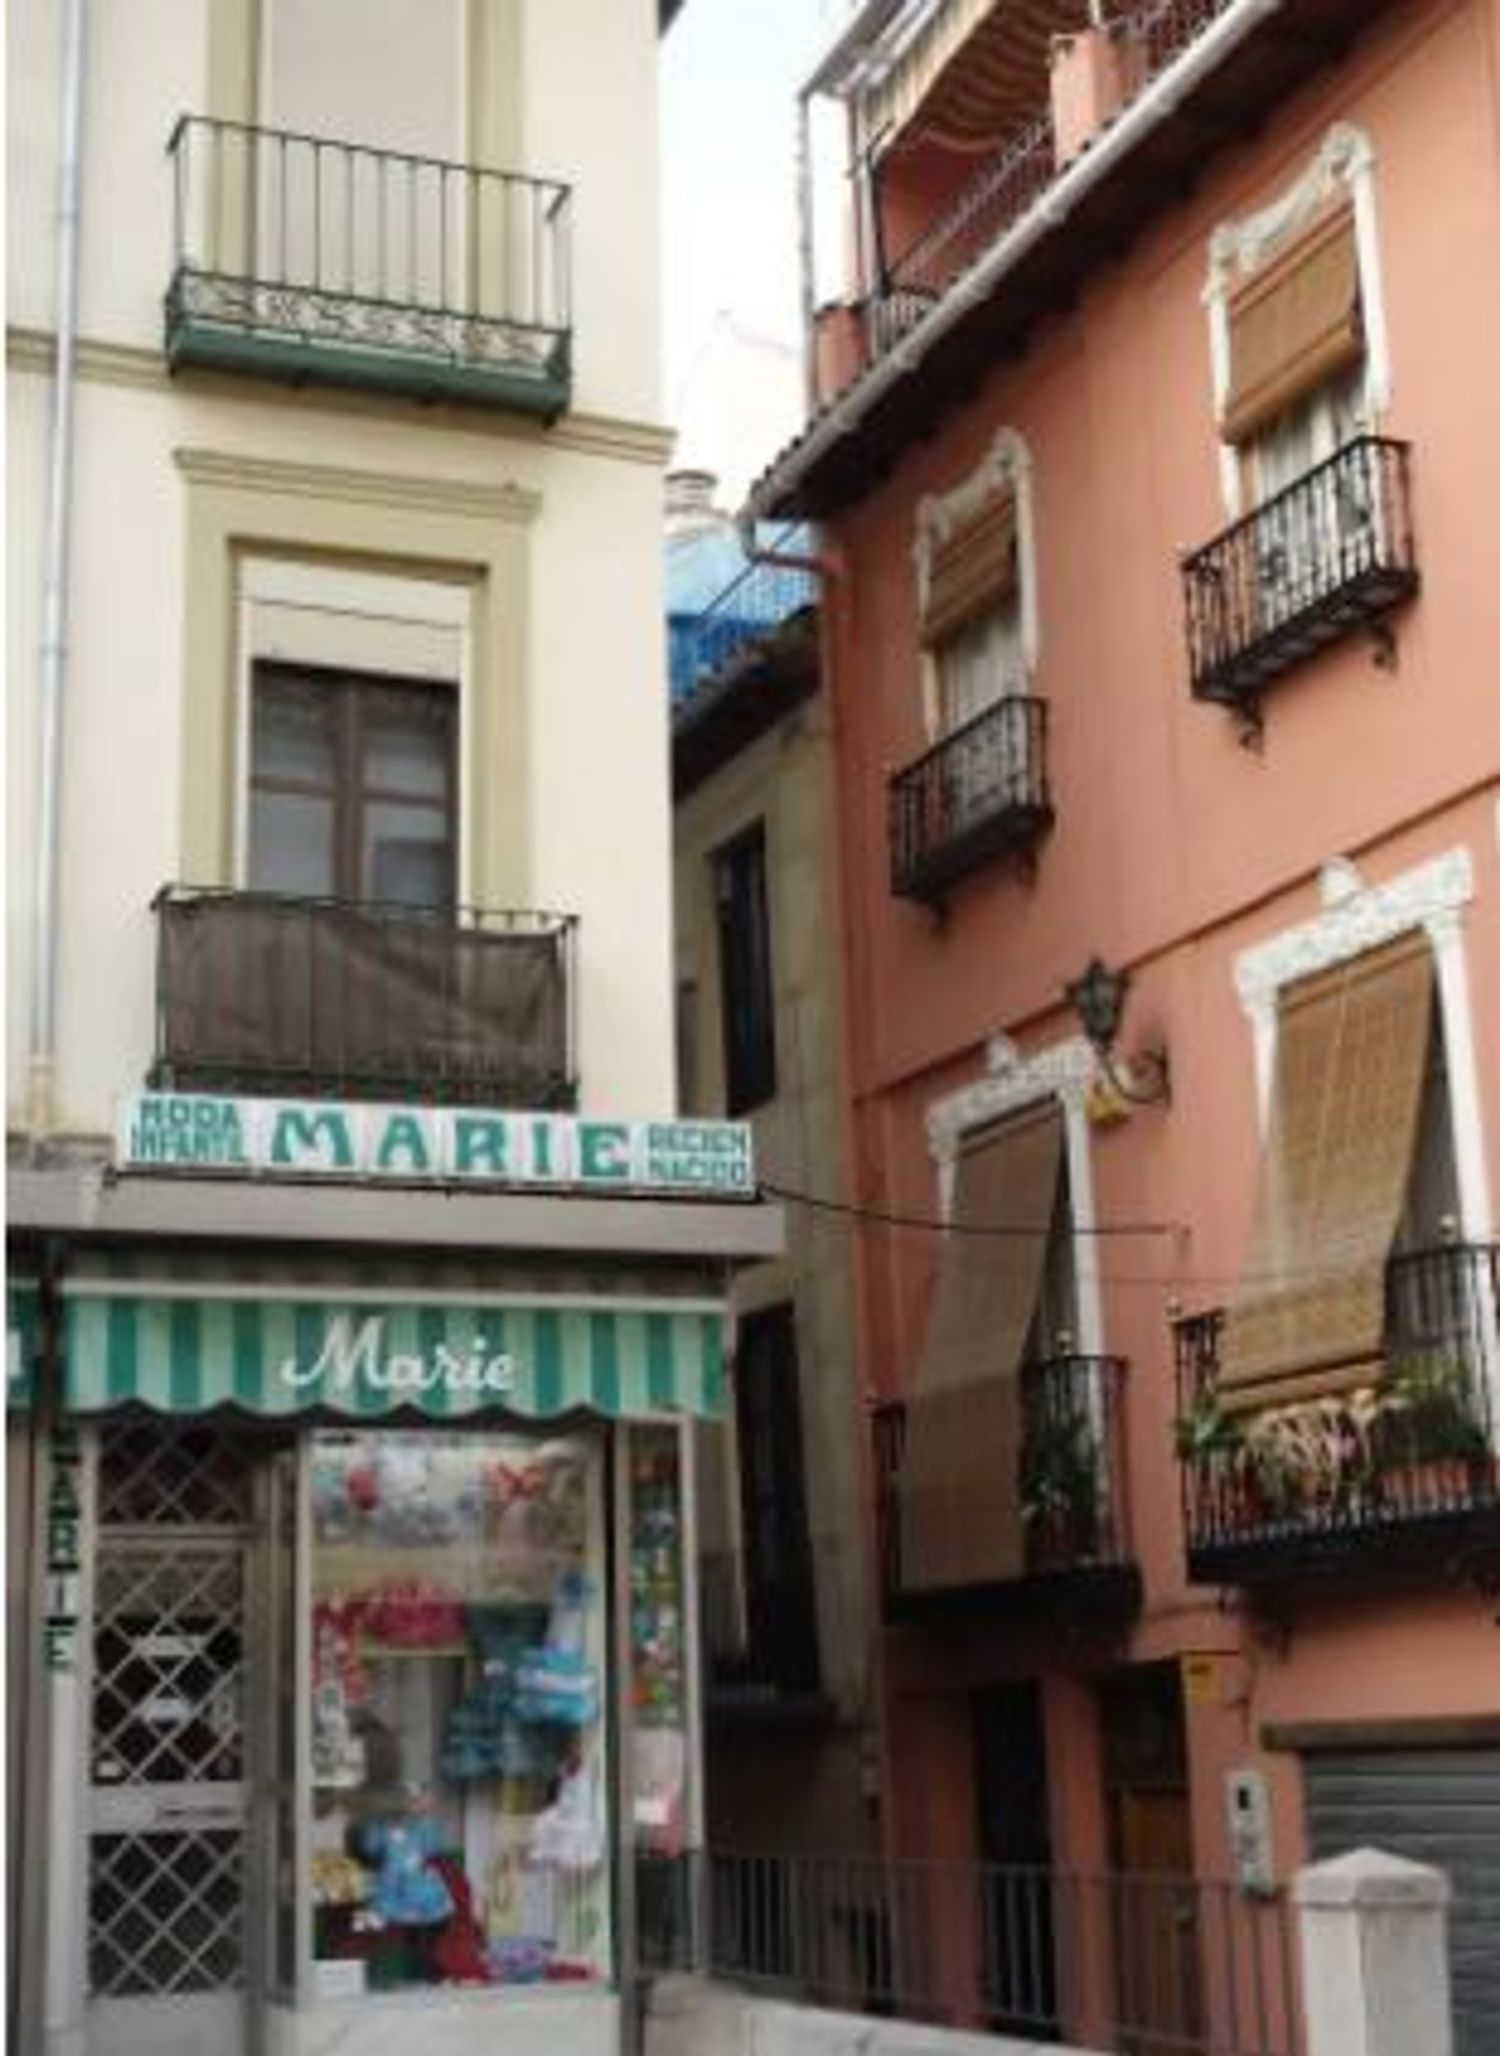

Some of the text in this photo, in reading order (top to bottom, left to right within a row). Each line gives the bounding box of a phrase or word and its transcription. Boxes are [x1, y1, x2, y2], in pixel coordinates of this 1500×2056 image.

[141, 1099, 239, 1129] MODA
[270, 1110, 629, 1178] MARIE
[282, 1316, 515, 1394] Marie
